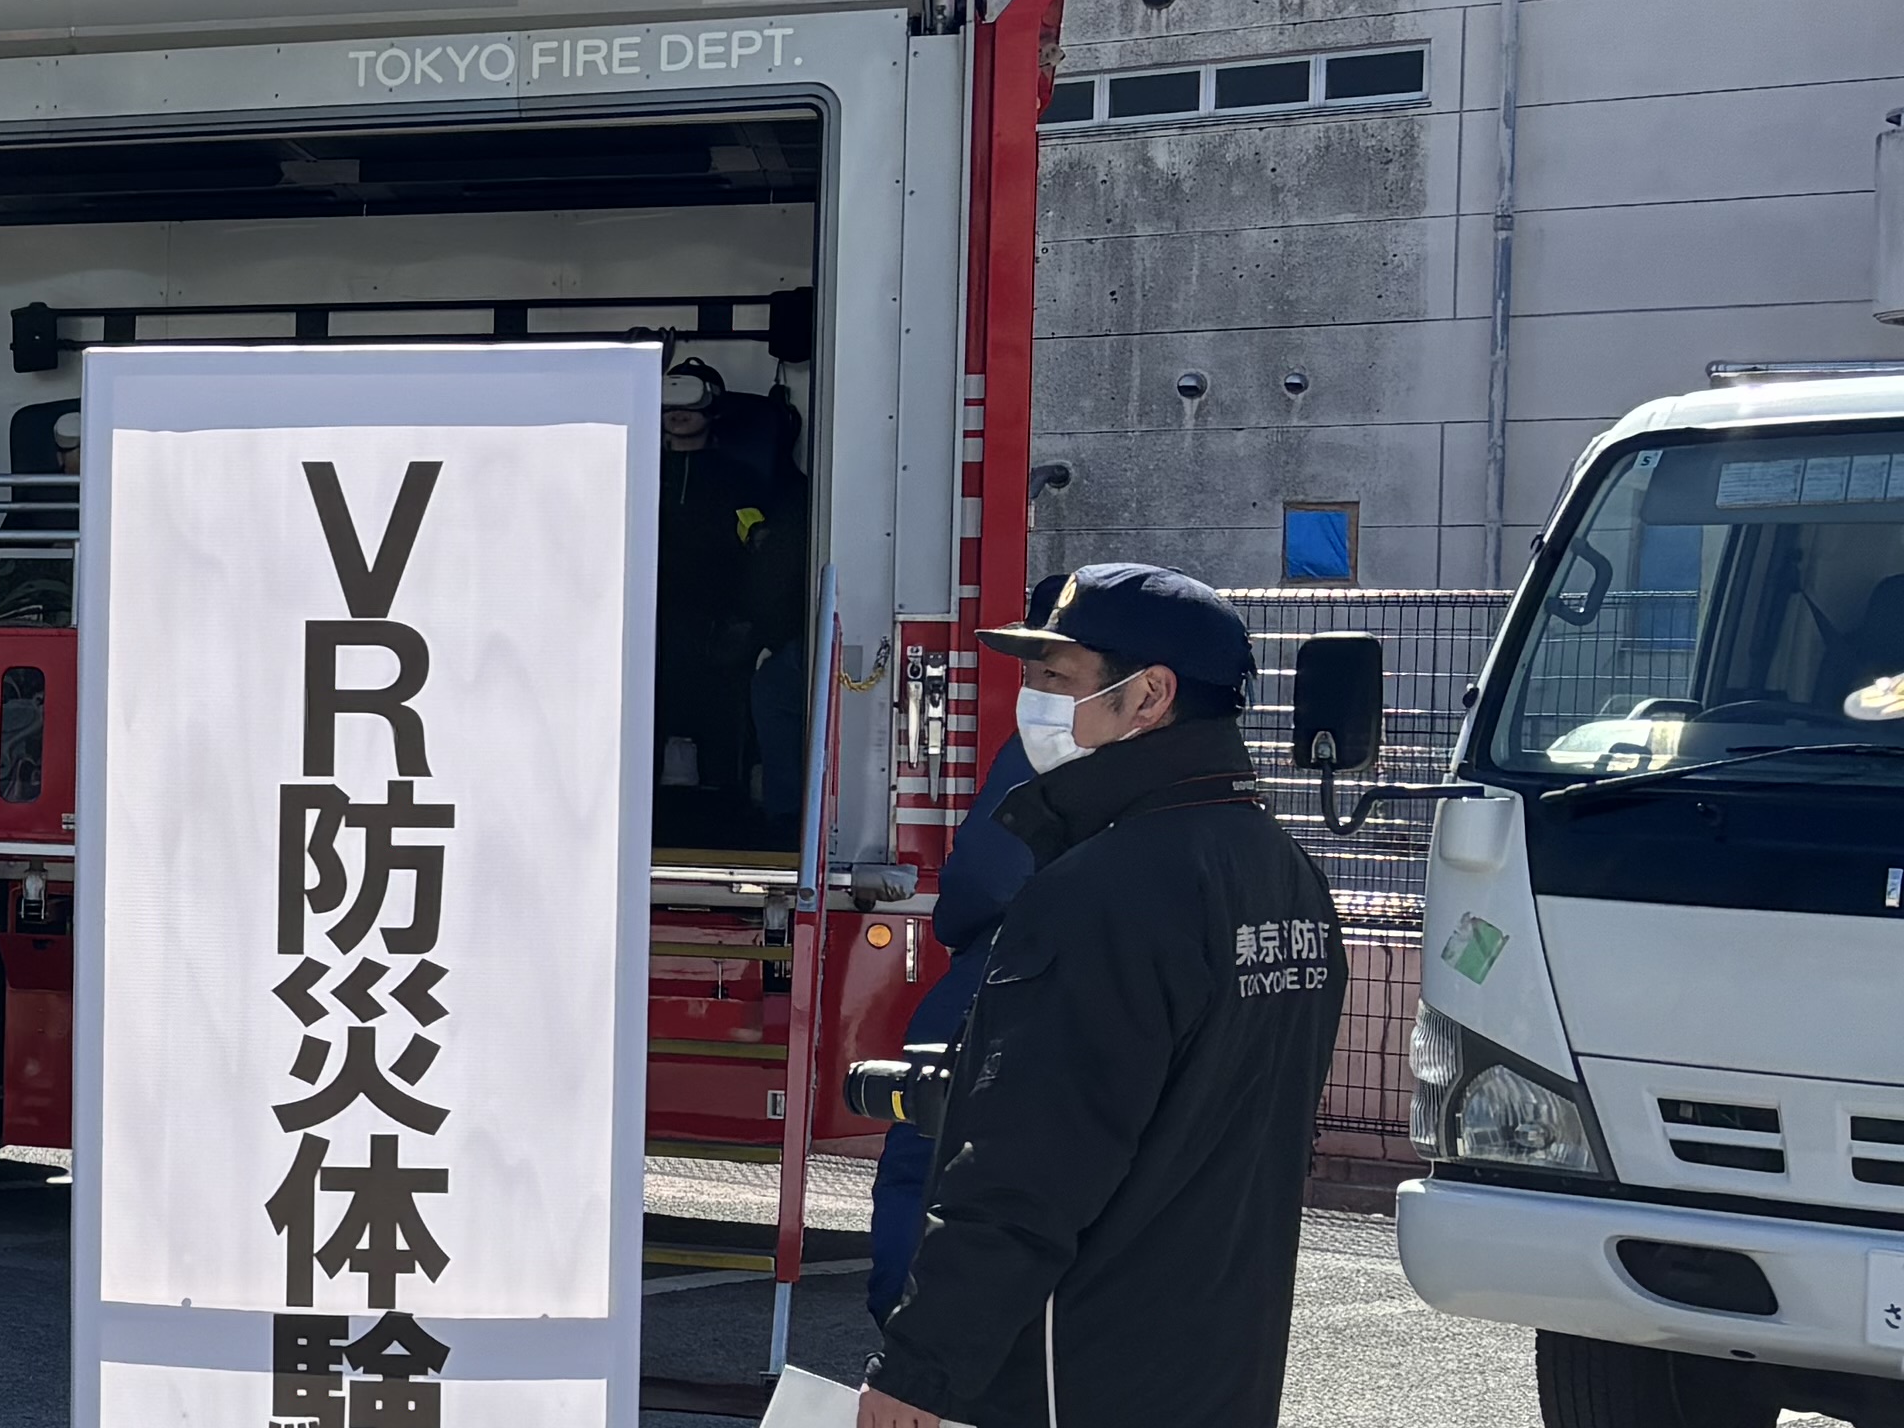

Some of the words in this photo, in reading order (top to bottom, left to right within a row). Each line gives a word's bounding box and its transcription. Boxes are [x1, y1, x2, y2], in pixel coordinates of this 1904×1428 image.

[348, 45, 513, 90] TOKYO
[530, 38, 641, 78] FIRE
[656, 29, 801, 72] DEPT.
